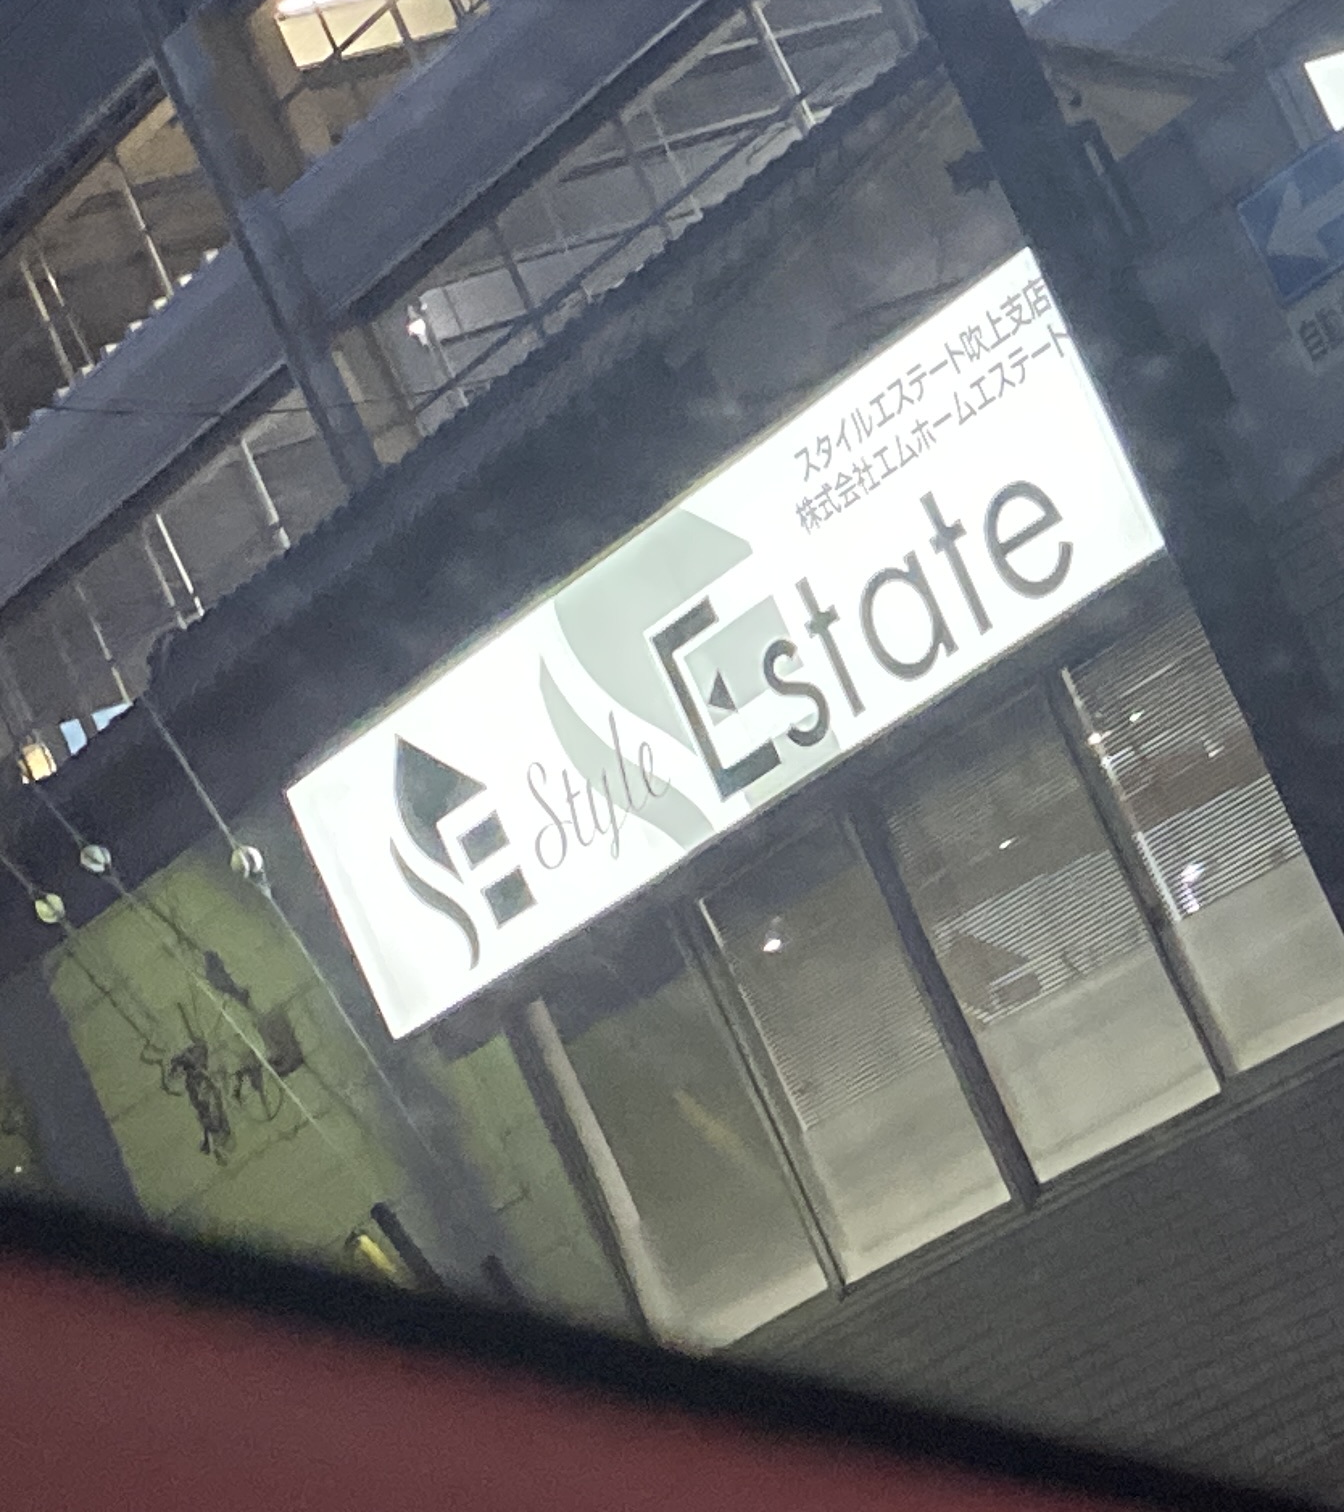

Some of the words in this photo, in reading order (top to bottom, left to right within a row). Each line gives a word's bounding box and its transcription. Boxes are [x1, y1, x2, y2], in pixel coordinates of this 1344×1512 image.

[793, 276, 1053, 482] スタイルエステート吹上支店
[795, 323, 1069, 535] 株式会社エムホームエステート
[524, 710, 672, 870] Style
[650, 480, 1075, 802] Estate
